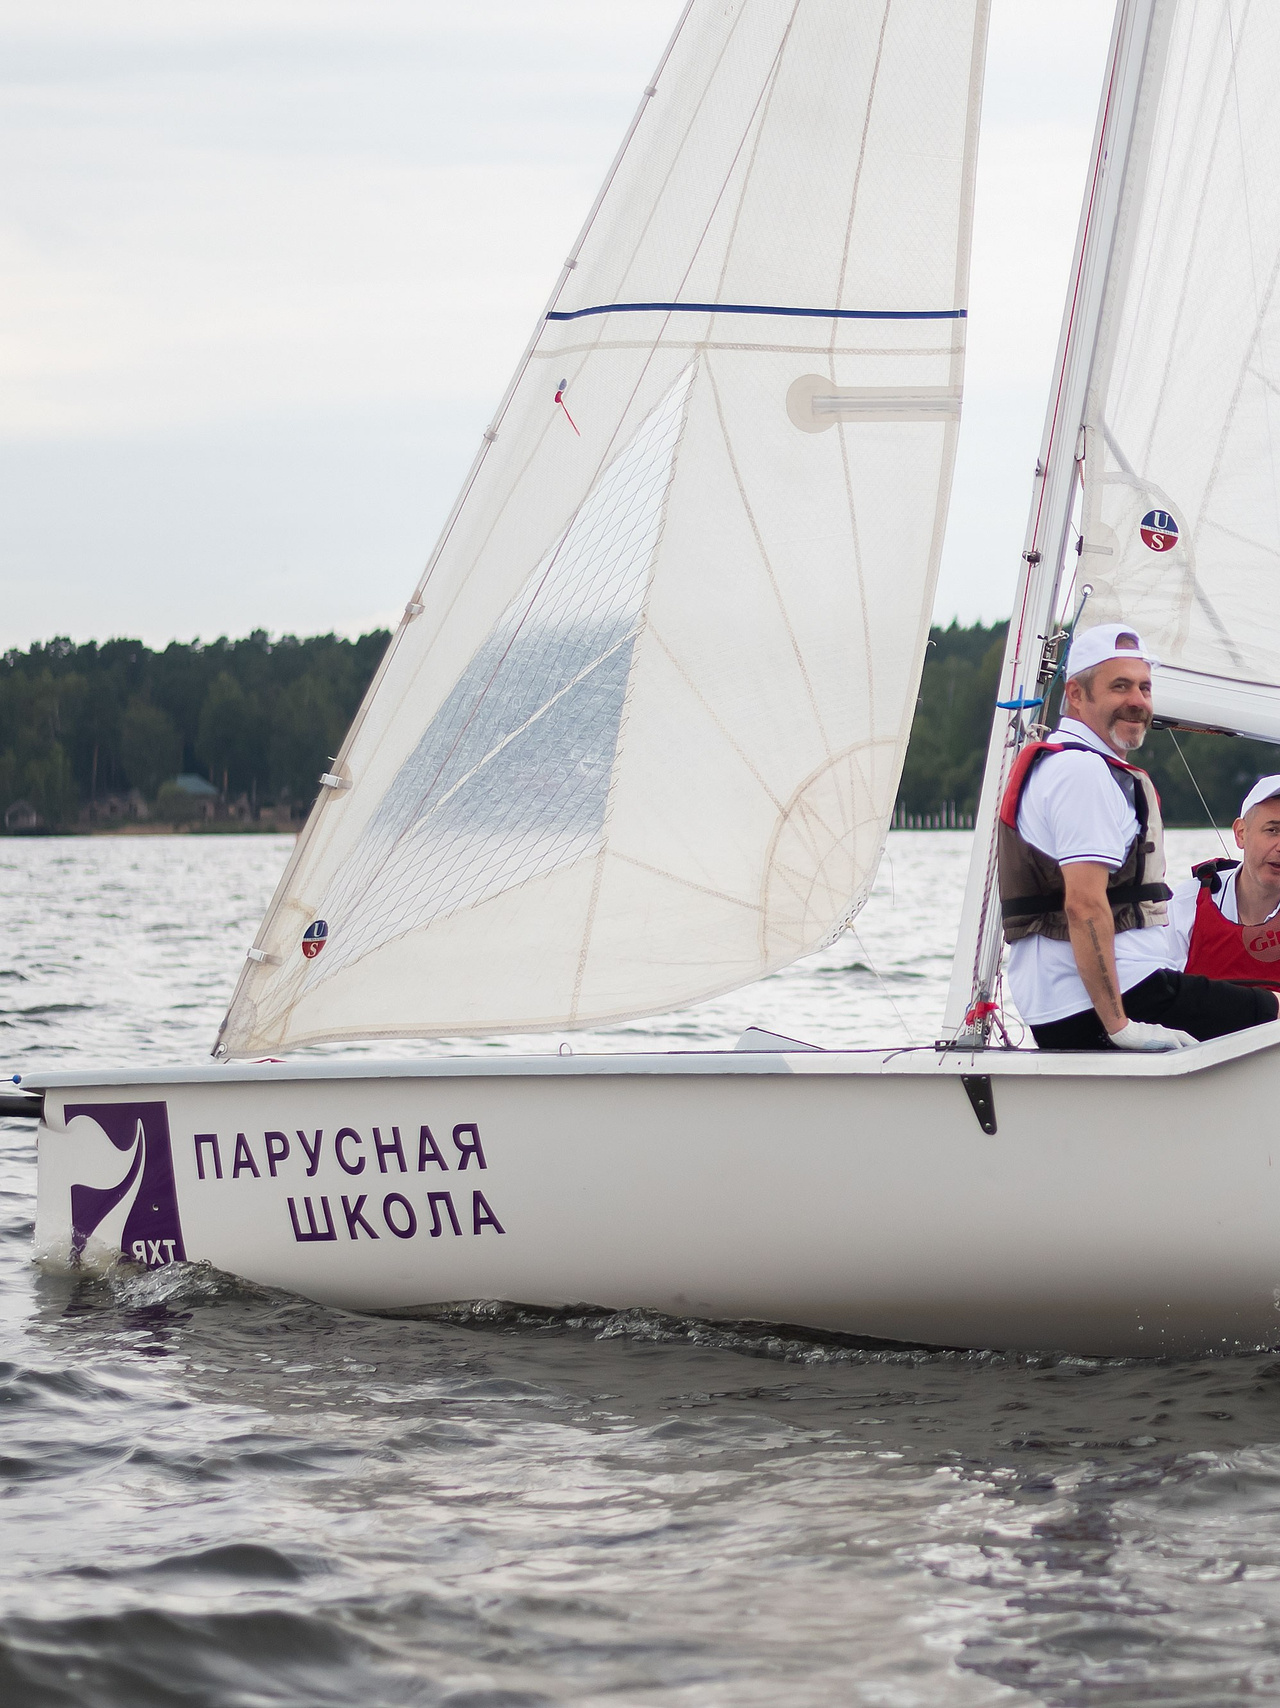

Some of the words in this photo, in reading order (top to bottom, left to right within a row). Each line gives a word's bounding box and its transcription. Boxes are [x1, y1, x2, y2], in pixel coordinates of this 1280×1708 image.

[193, 1122, 488, 1180] ПАРУСНАЯ
[286, 1189, 506, 1242] ШКОЛА
[132, 1239, 176, 1265] ЯХТ
